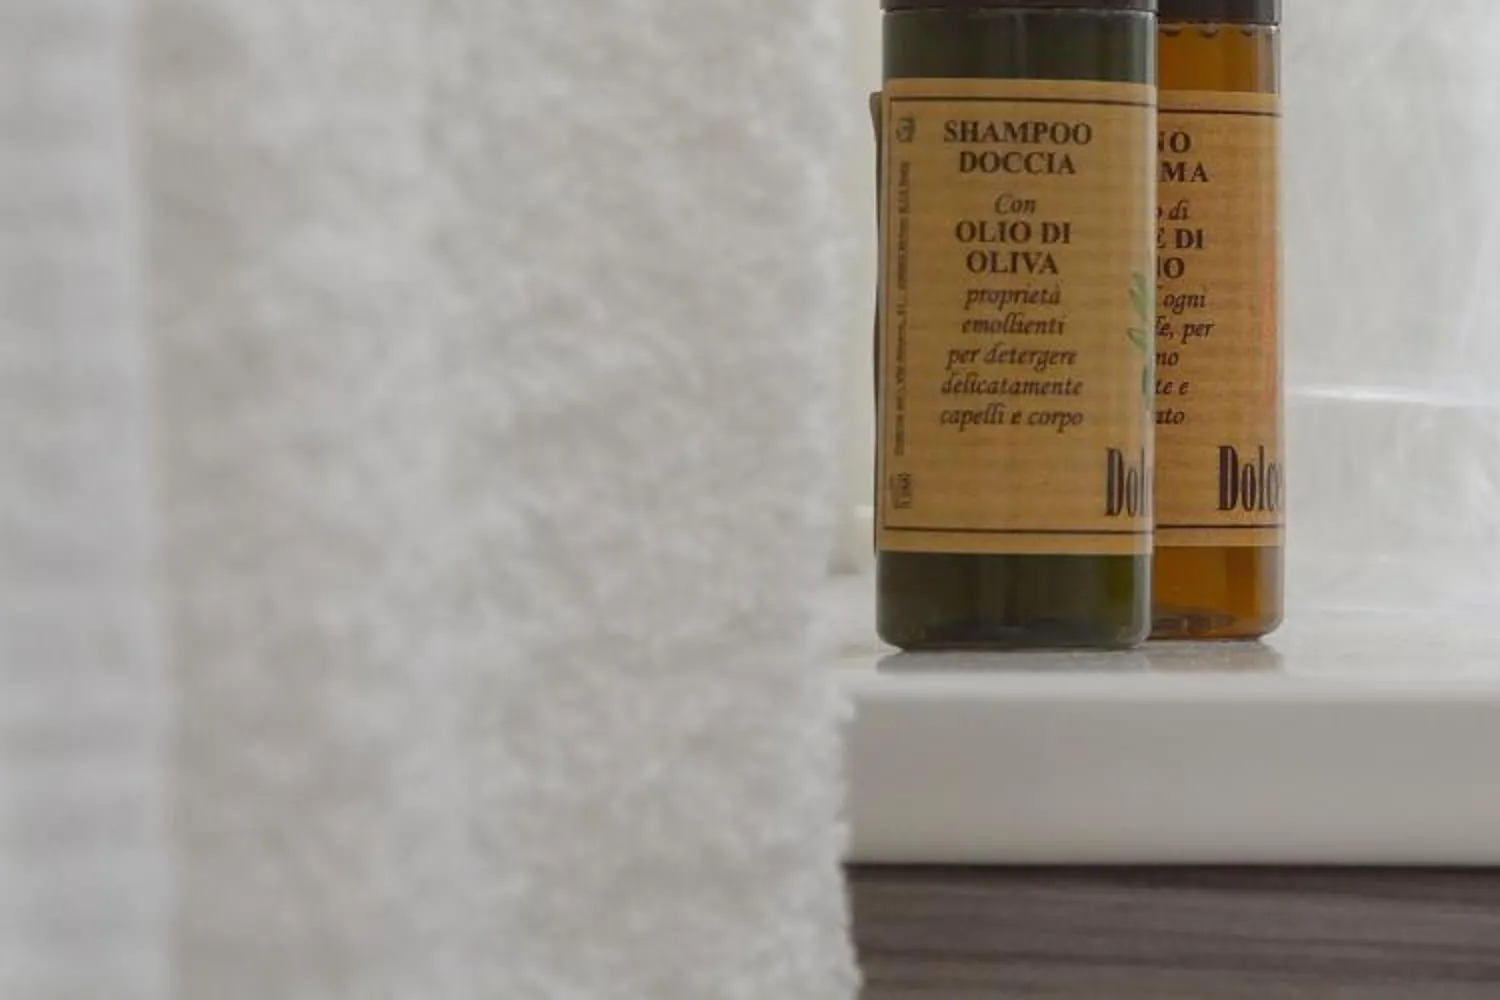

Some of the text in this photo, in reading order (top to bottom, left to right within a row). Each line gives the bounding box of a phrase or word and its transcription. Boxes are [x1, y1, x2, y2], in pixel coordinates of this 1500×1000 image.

[943, 119, 1093, 145] SHAMPOO
[959, 150, 1077, 175] DOCCIA
[994, 192, 1036, 215] Con
[955, 219, 1071, 245] OLIO DI
[1174, 228, 1204, 249] DI
[965, 250, 1060, 276] OLIVA
[961, 311, 1066, 336] emollienti
[1181, 321, 1216, 344] per
[945, 342, 1078, 373] per detergere
[940, 371, 1084, 397] delicatamente
[940, 402, 1084, 434] capelli e corpo
